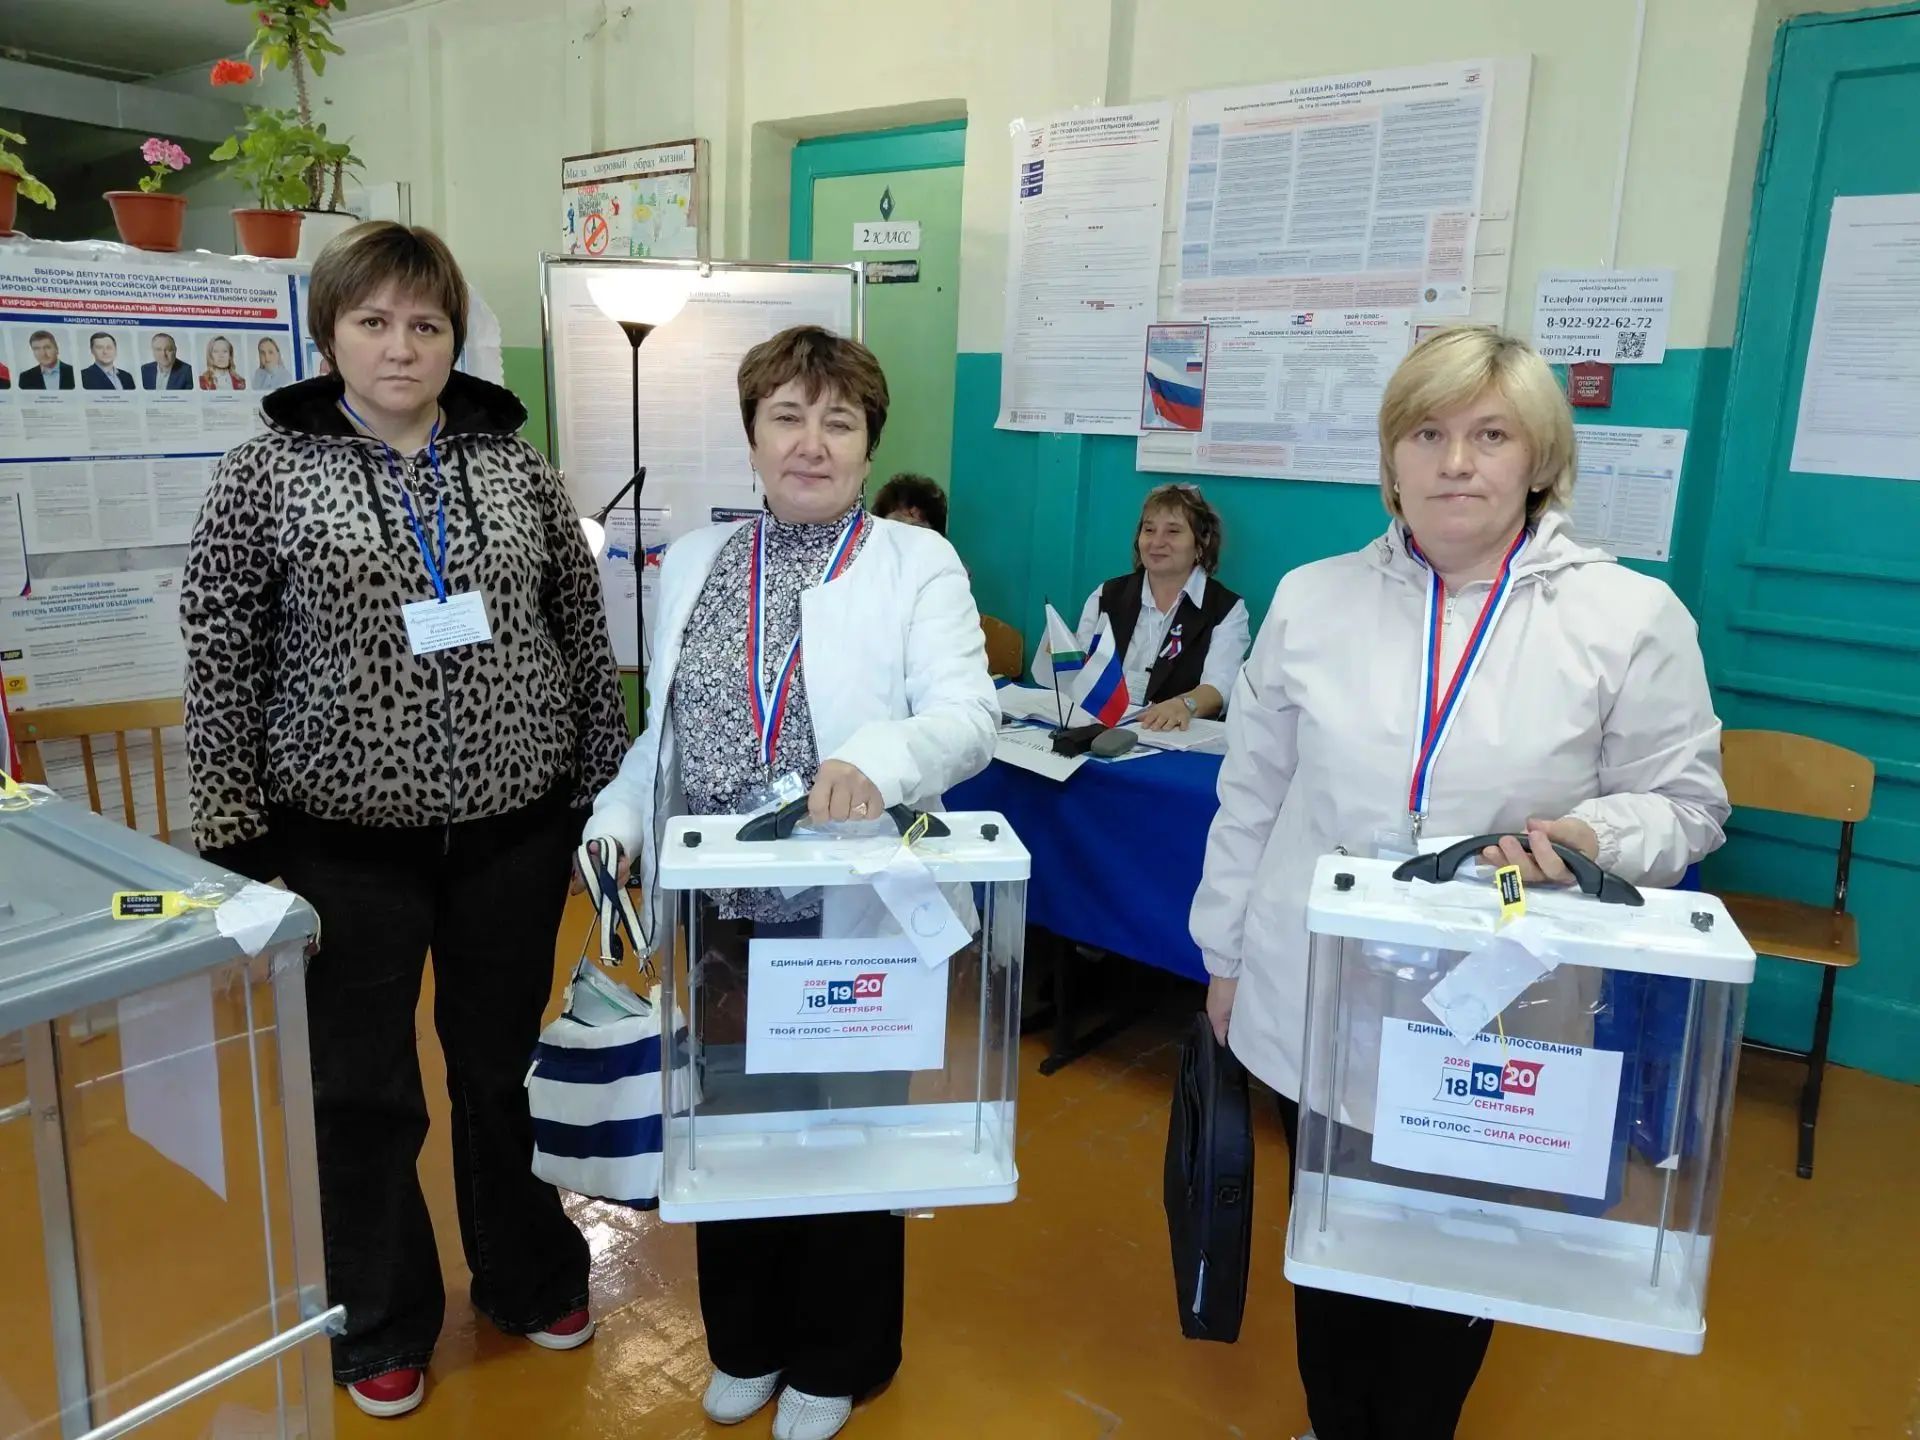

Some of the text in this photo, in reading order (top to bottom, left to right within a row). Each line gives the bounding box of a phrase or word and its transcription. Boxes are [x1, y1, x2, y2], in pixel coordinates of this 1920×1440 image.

[1289, 80, 1371, 95] КАЛЕНДАРЬ ВЫБОРОВ
[633, 157, 655, 172] образ
[659, 150, 686, 163] жизни!
[863, 229, 870, 242] 2
[34, 267, 74, 277] ВЫБОРЫ
[76, 271, 126, 280] ДЕПУТАТОВ
[127, 274, 208, 283] ГОСУДАРСТВЕННОЙ
[0, 274, 49, 284] РАЛЬНОГО
[51, 278, 98, 287] СОБРАНИЯ
[100, 280, 157, 290] РОССИЙСКОЙ
[160, 284, 209, 293] ФЕДЕРАЦИИ
[211, 286, 247, 295] ДЕВЯТОГО
[0, 284, 91, 296] ИРОВО-ЧЕПЕЦКОМУ
[94, 289, 176, 299] ОДНОМАНДАТНОМУ
[178, 293, 248, 302] ИЗБИРАТЕЛЬНОМУ
[1543, 295, 1664, 306] Телефон горячей линии
[2, 299, 84, 310] КИРОВО-ЧЕПЕЦКИЙ
[85, 303, 157, 313] ОДНОМАНДАТНЫЙ
[159, 306, 220, 314] ИЗБИРАТЕЛЬНЫЙ
[63, 317, 102, 325] КАНДИДАТЫ
[1546, 316, 1653, 328] 8-922-922-62-72
[12, 608, 47, 617] ПЕРЕЧЕНЬ
[49, 603, 104, 614] ИЗБИРАТЕЛЬНЫХ
[771, 957, 917, 967] ЕДИНЫЙ ДЕНЬ ГОЛОСОВАНИЯ
[806, 979, 880, 1008] 18 19 20
[832, 1005, 882, 1013] СЕНТЯБРЯ
[769, 1026, 795, 1035] ТВОЙ
[798, 1026, 831, 1035] ГОЛОС
[842, 1025, 868, 1033] СИЛА
[871, 1024, 913, 1032] РОССИИ!
[1494, 1035, 1583, 1057] ГОЛОСОВАНИЯ
[1443, 1056, 1471, 1068] 2026
[1445, 1066, 1535, 1097] 18 19 20
[1474, 1099, 1535, 1116] СЕНТЯБРЯ
[1400, 1115, 1430, 1127] ТВОЙ
[1432, 1120, 1471, 1133] ГОЛОС
[1484, 1128, 1516, 1141] СИЛА
[1518, 1133, 1571, 1150] РОССИИ!
